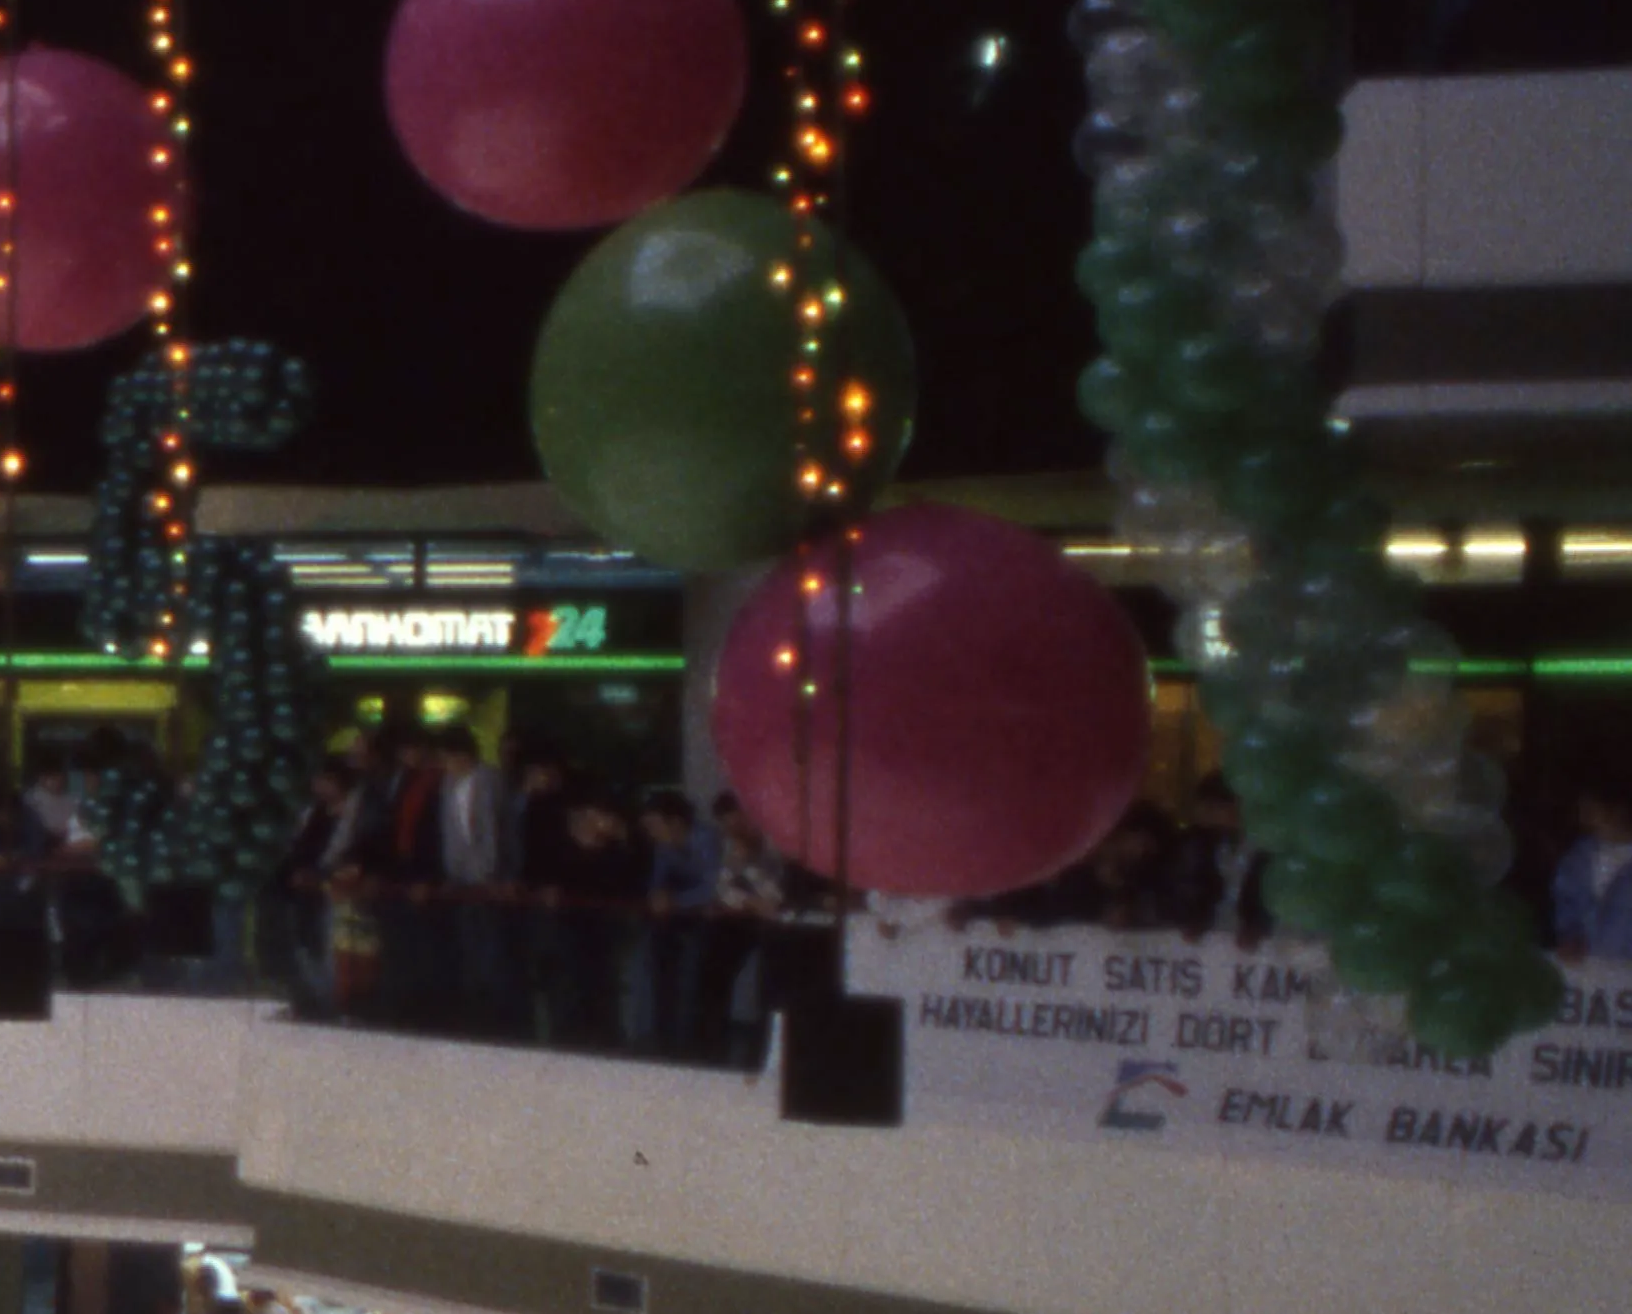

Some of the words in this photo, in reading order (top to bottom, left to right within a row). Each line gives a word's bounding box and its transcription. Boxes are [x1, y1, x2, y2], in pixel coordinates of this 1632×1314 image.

[962, 945, 1076, 986] KONUT
[1217, 1089, 1354, 1138] EMLAK
[1386, 1105, 1590, 1162] BANKASI
